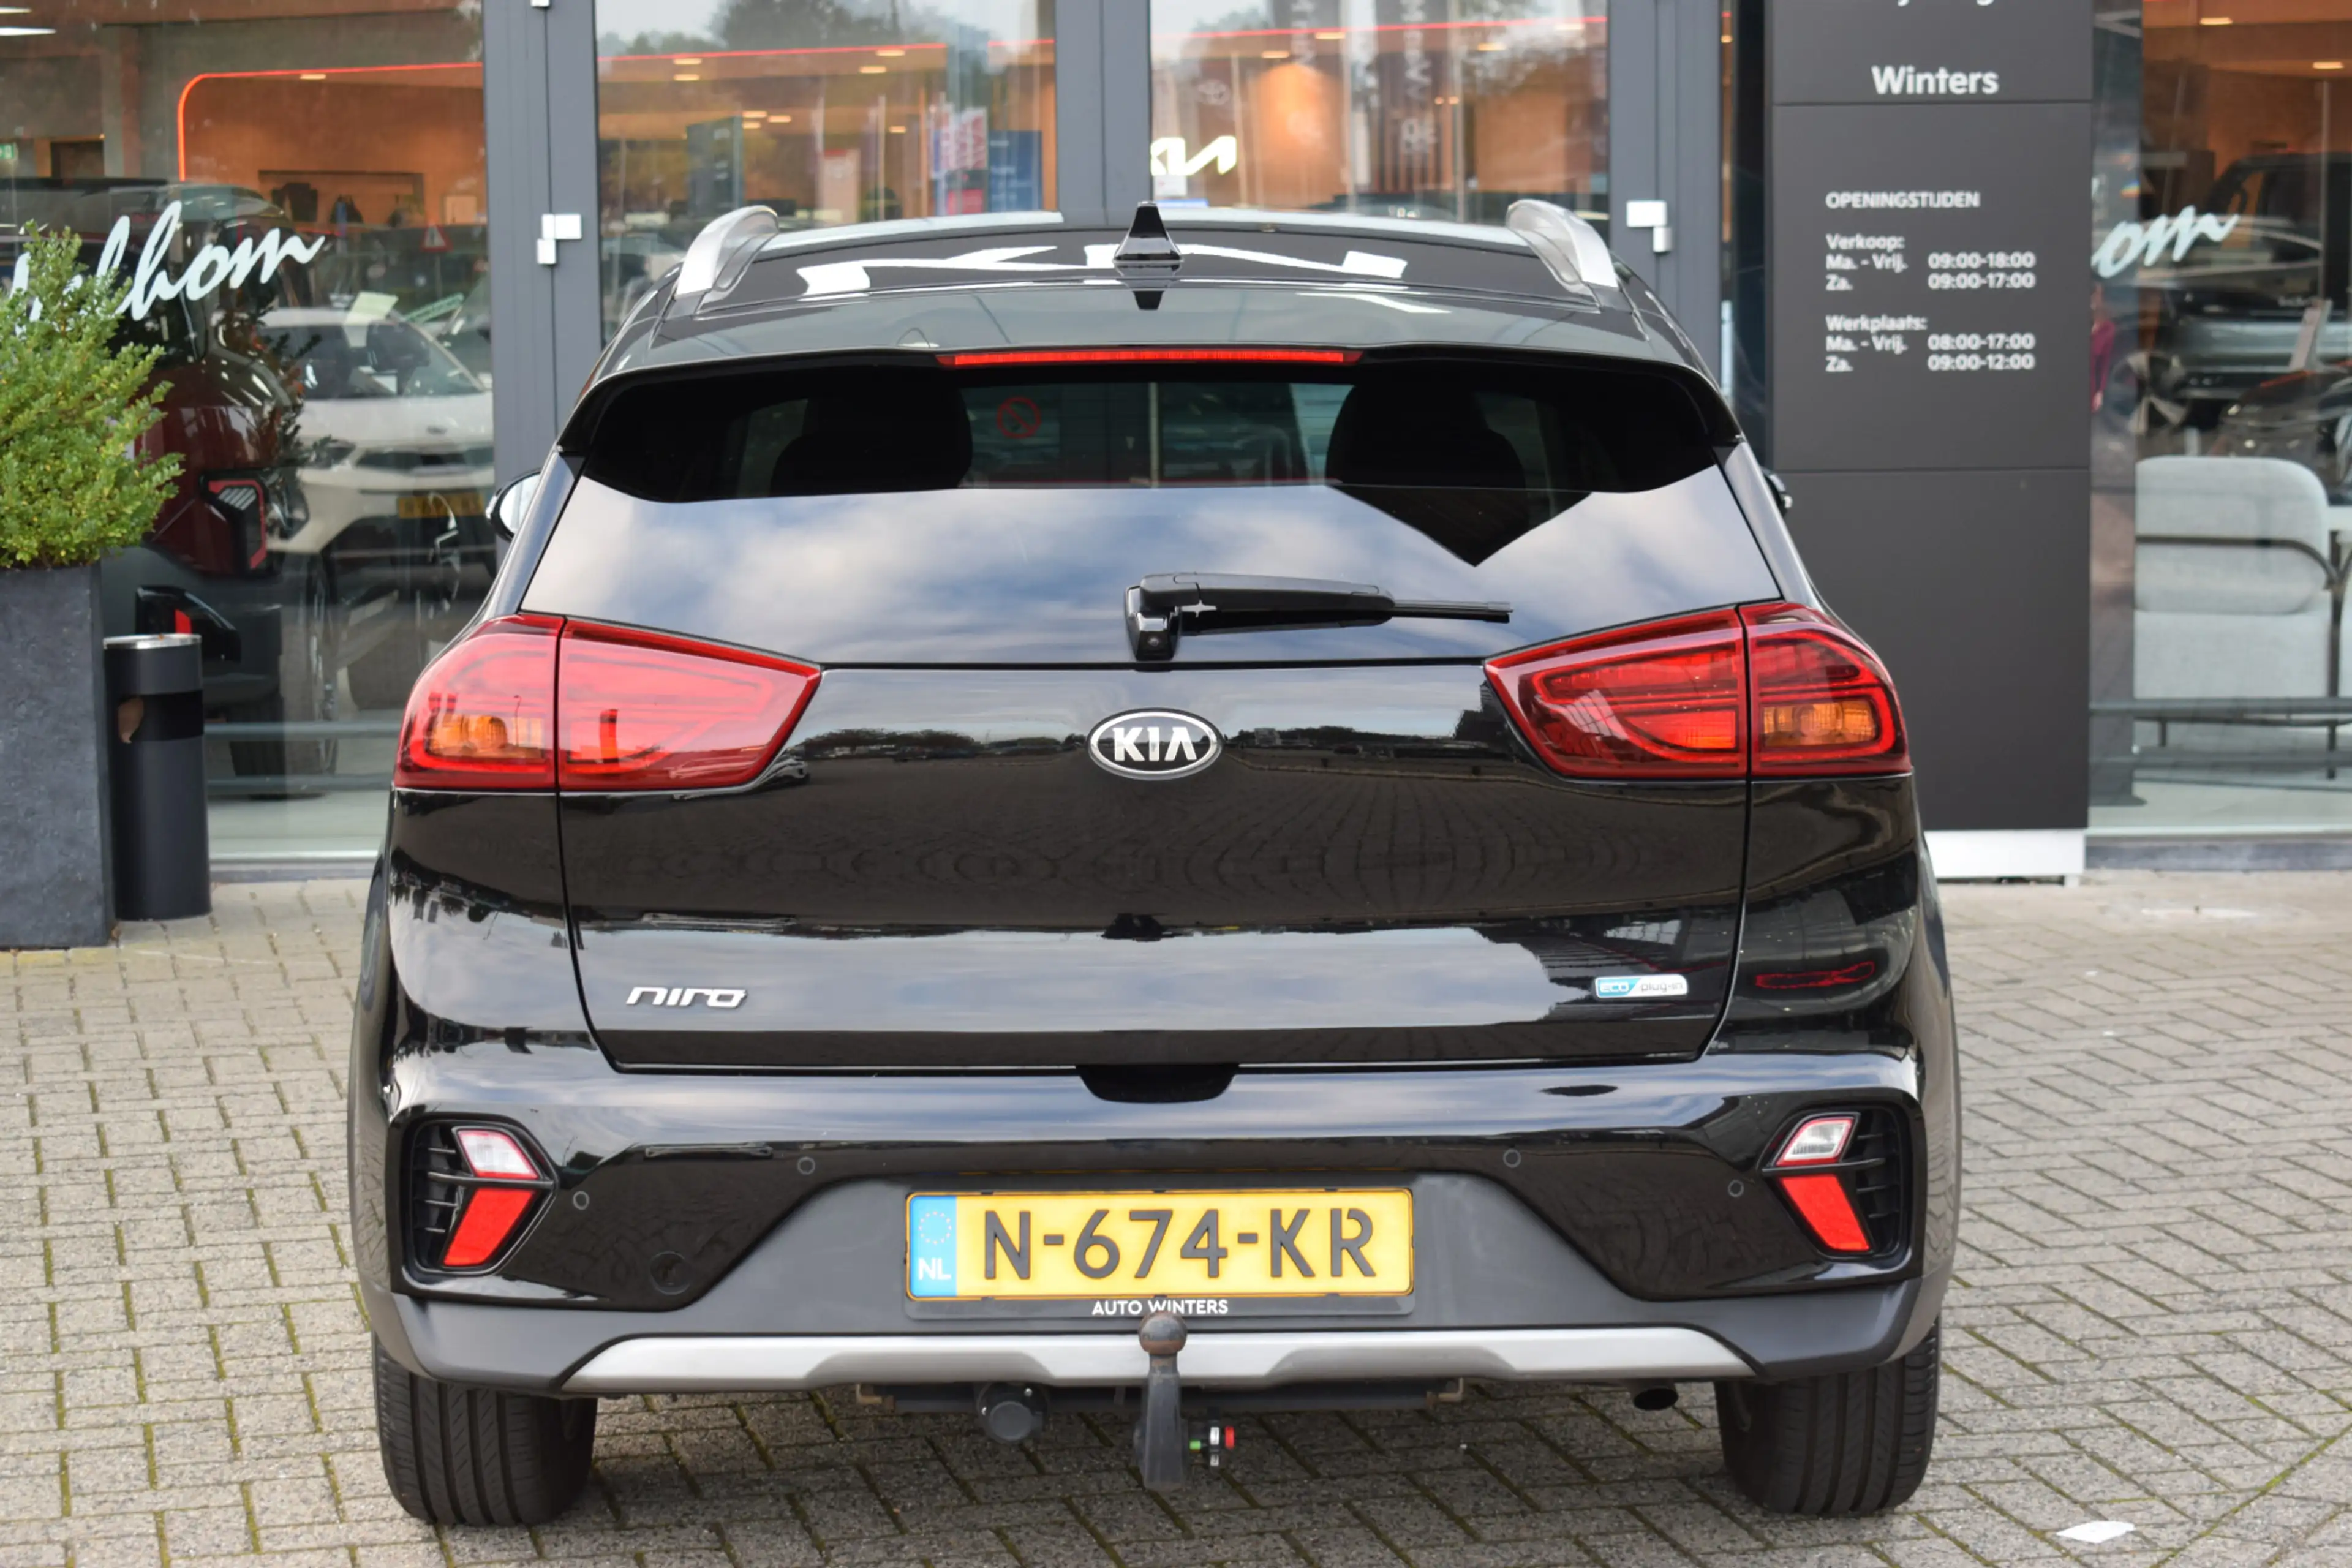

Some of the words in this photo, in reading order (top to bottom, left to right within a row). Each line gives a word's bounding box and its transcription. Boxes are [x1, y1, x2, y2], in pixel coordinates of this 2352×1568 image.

[1871, 64, 1999, 95] Winters
[1825, 233, 1905, 252] Verkoop:
[1826, 254, 1858, 270] Ma.
[1872, 253, 1908, 273] Vrij.
[1928, 252, 2036, 270] 09:00-18:00
[1825, 274, 1853, 291] Za.
[1928, 272, 2036, 290] 09:00-17:00
[1825, 314, 1928, 334] Werkplaats:
[1826, 335, 1858, 352] Ma.
[1871, 334, 1908, 355] Vrij.
[1927, 333, 2036, 351] 08:00-17:00
[1825, 355, 1853, 372] Za.
[1927, 353, 2035, 371] 09:00-12:00
[1112, 726, 1197, 761] KIA
[984, 1208, 1376, 1280] N-674-KR
[918, 1257, 951, 1280] NL
[1091, 1300, 1143, 1316] AUTO
[1147, 1299, 1229, 1315] WINTERS
